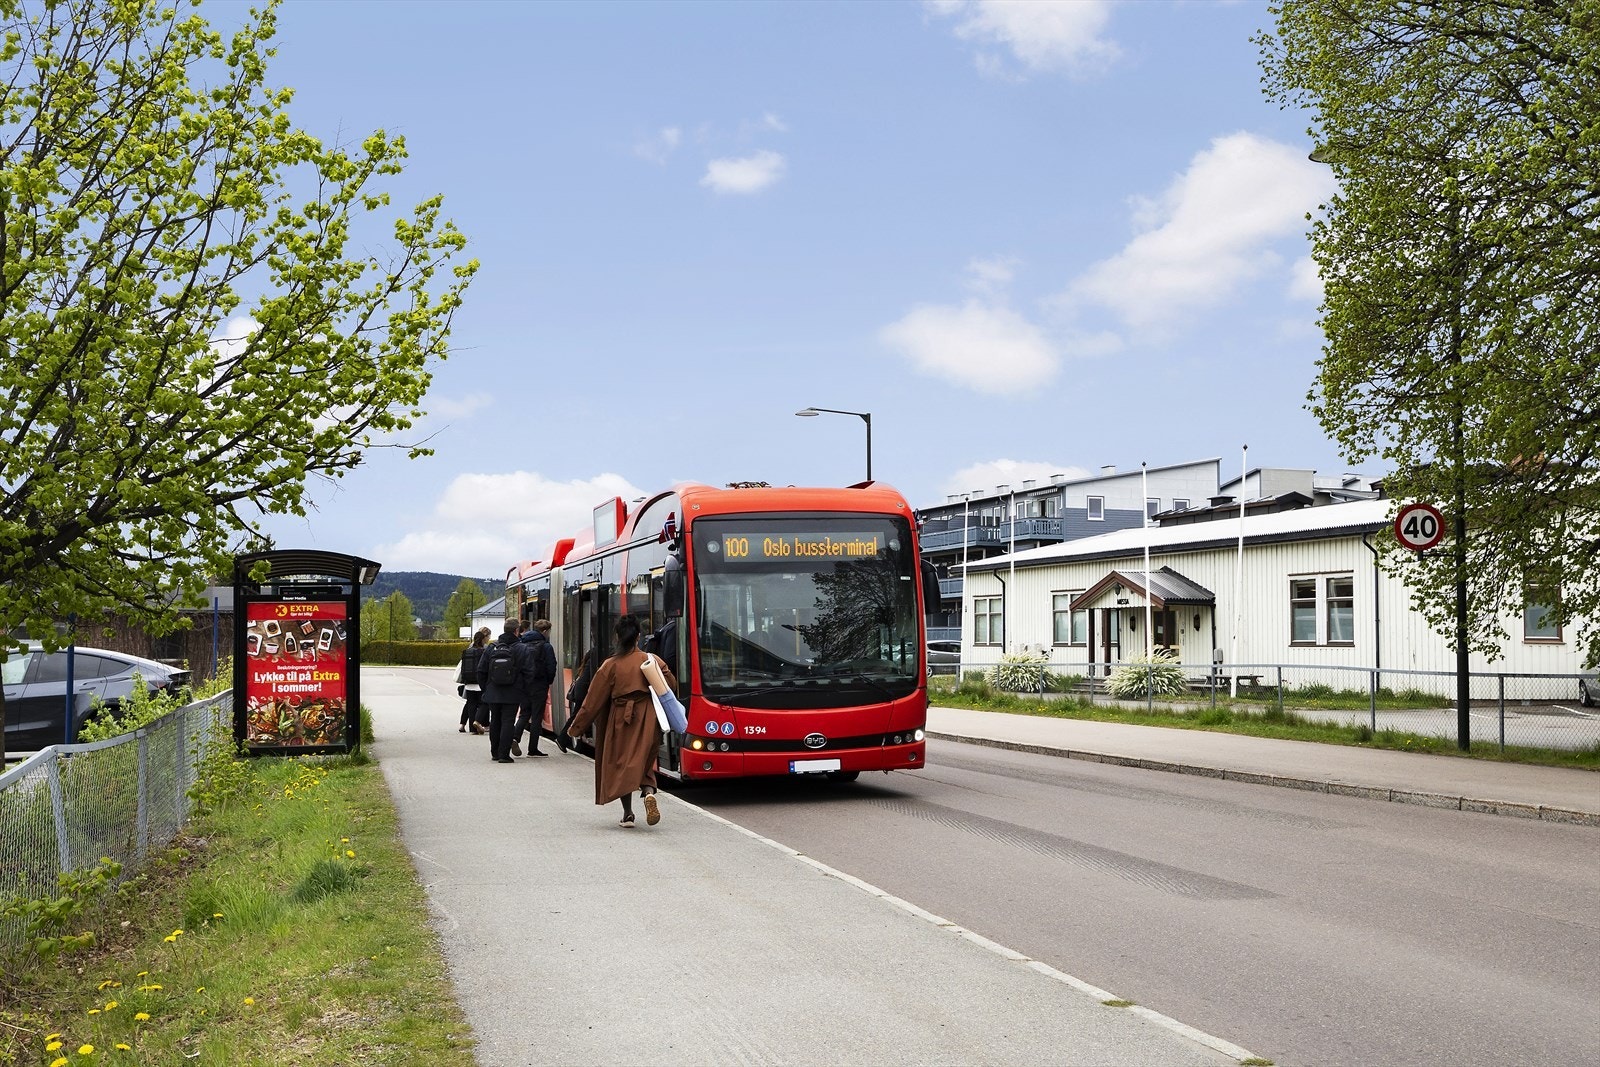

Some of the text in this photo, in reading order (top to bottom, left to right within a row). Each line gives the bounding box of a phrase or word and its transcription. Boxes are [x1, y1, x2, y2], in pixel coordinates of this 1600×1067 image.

[1403, 515, 1436, 538] 40
[725, 536, 878, 557] 100 Oslo bussterminal
[254, 671, 340, 683] Lykke til på Extra
[278, 682, 322, 692] sommer!
